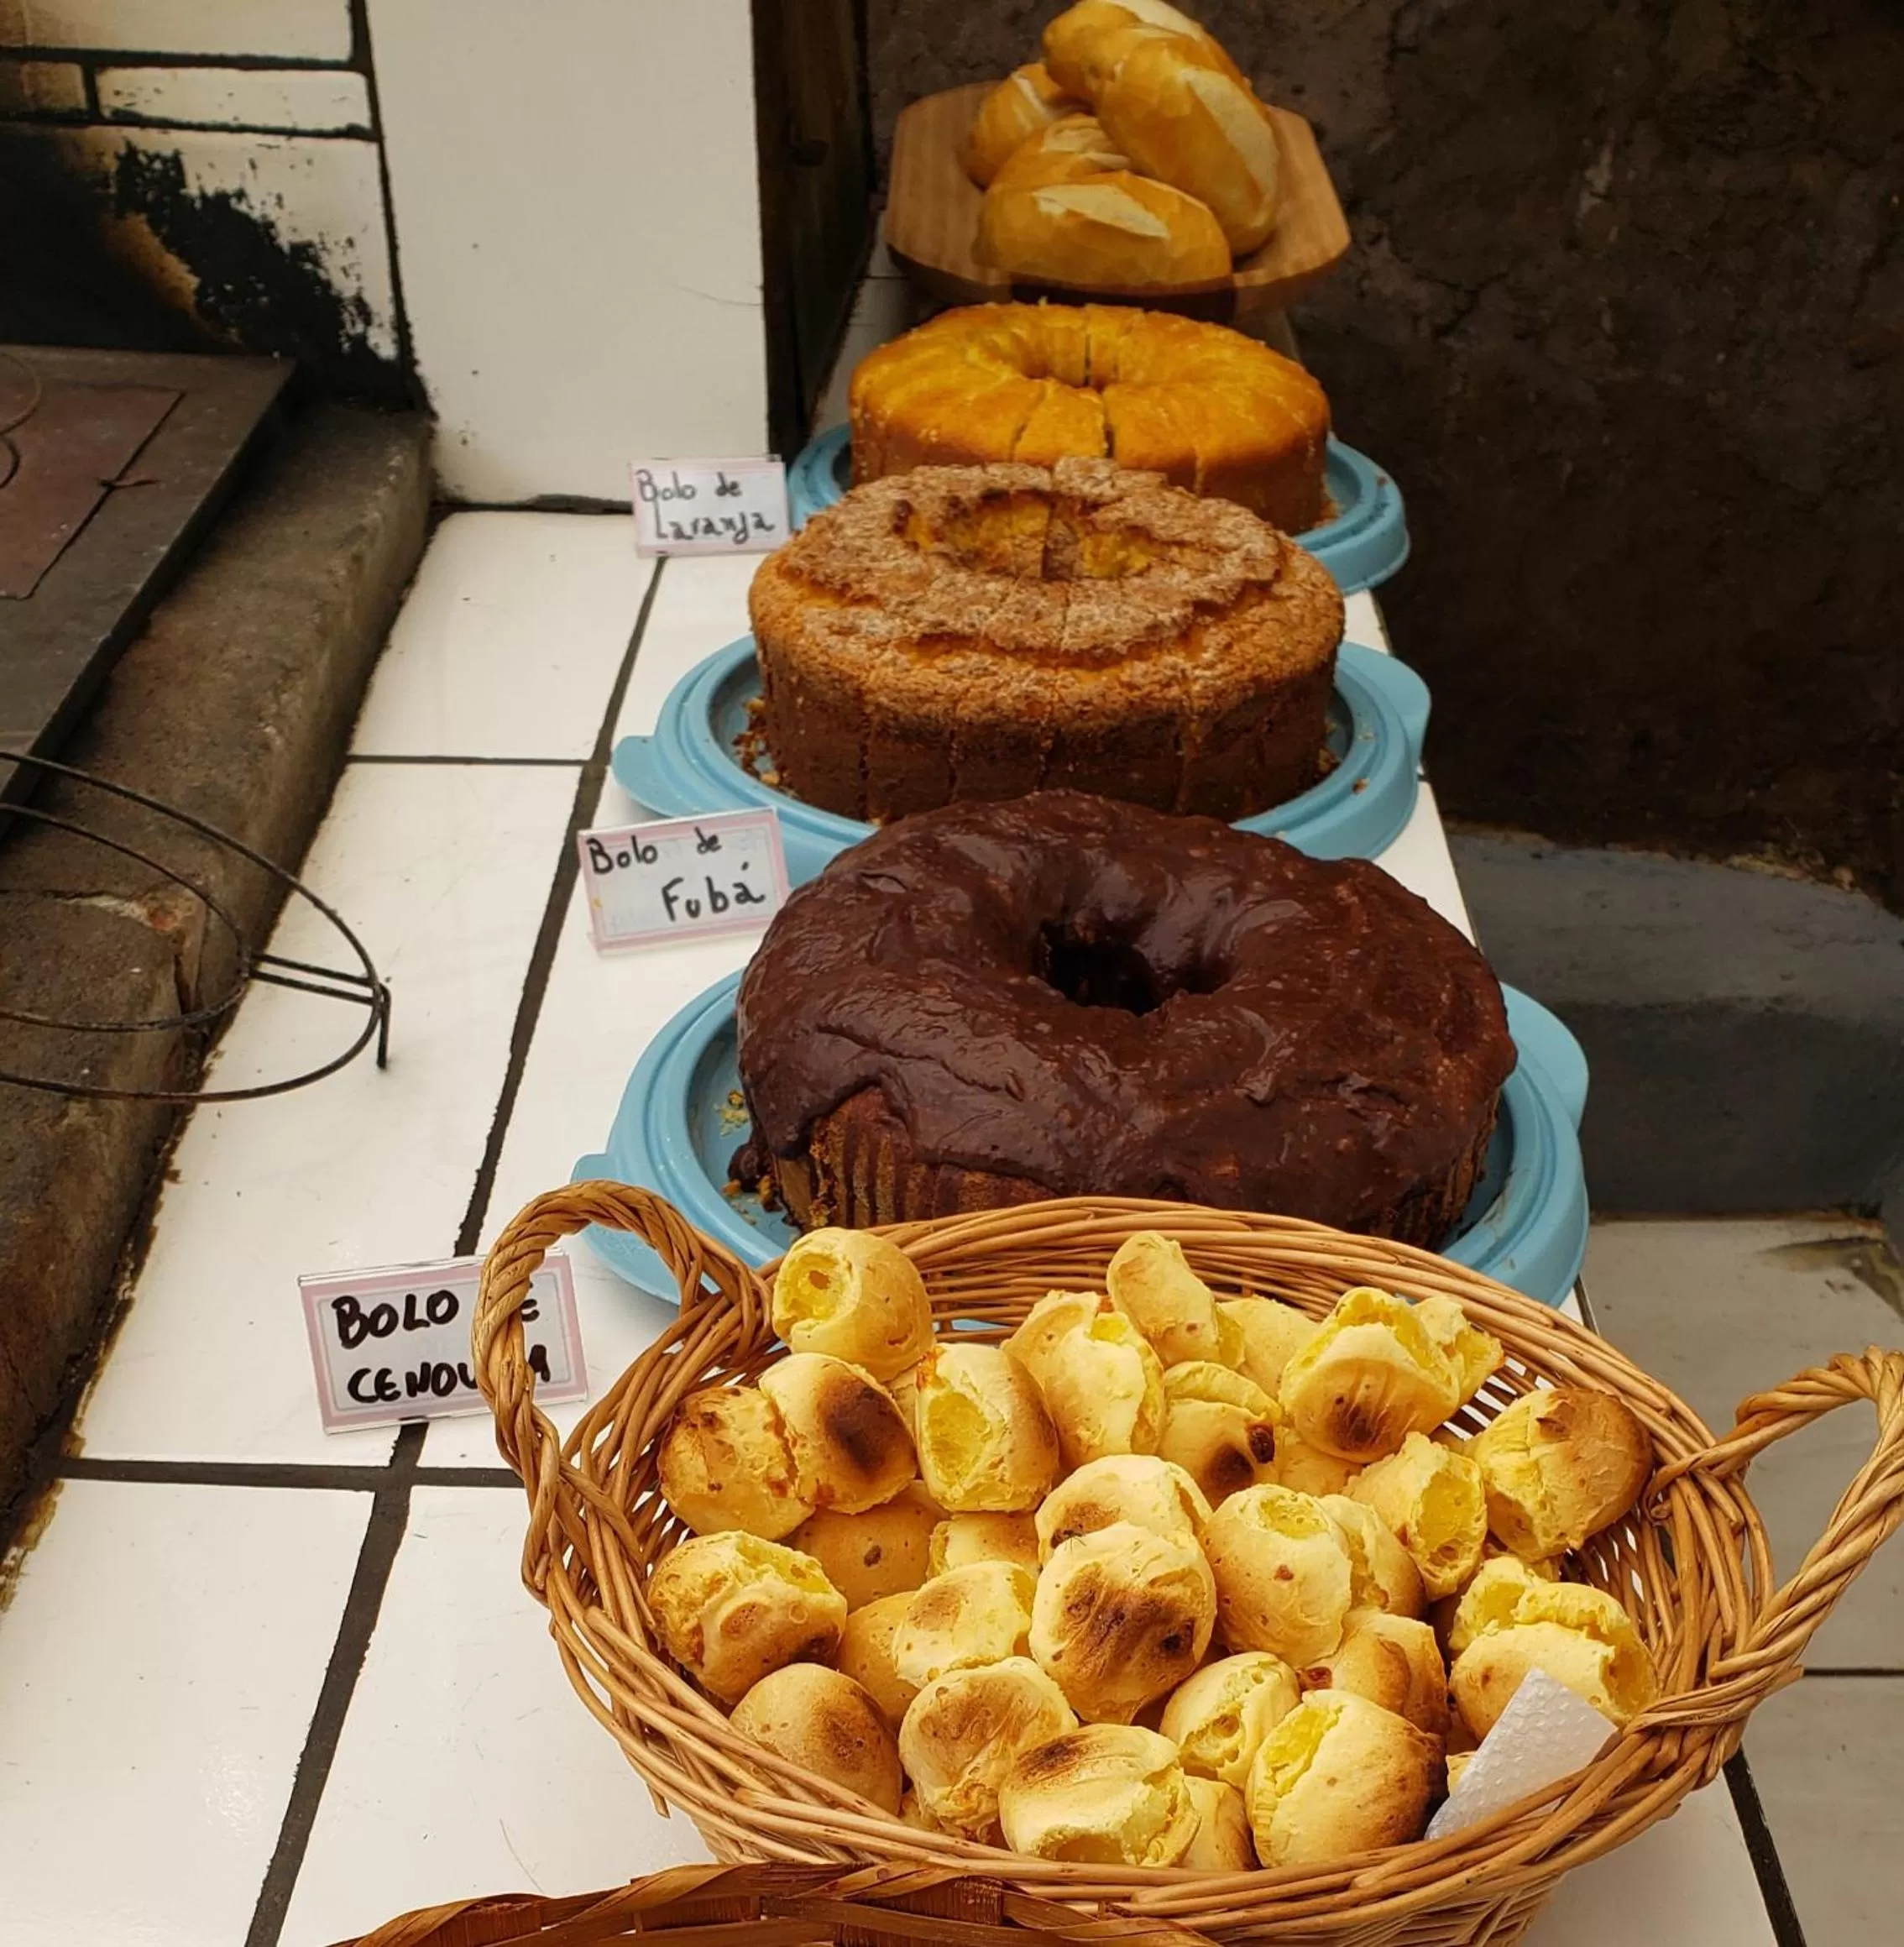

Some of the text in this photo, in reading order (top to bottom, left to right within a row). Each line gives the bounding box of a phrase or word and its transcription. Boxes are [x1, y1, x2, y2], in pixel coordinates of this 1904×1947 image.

[635, 468, 742, 502] Bolo de
[652, 501, 776, 545] Laranja
[586, 826, 721, 875] Bolo de
[661, 861, 766, 922] Fubá
[332, 1290, 459, 1349] BOLO
[347, 1343, 551, 1403] CENOUA
